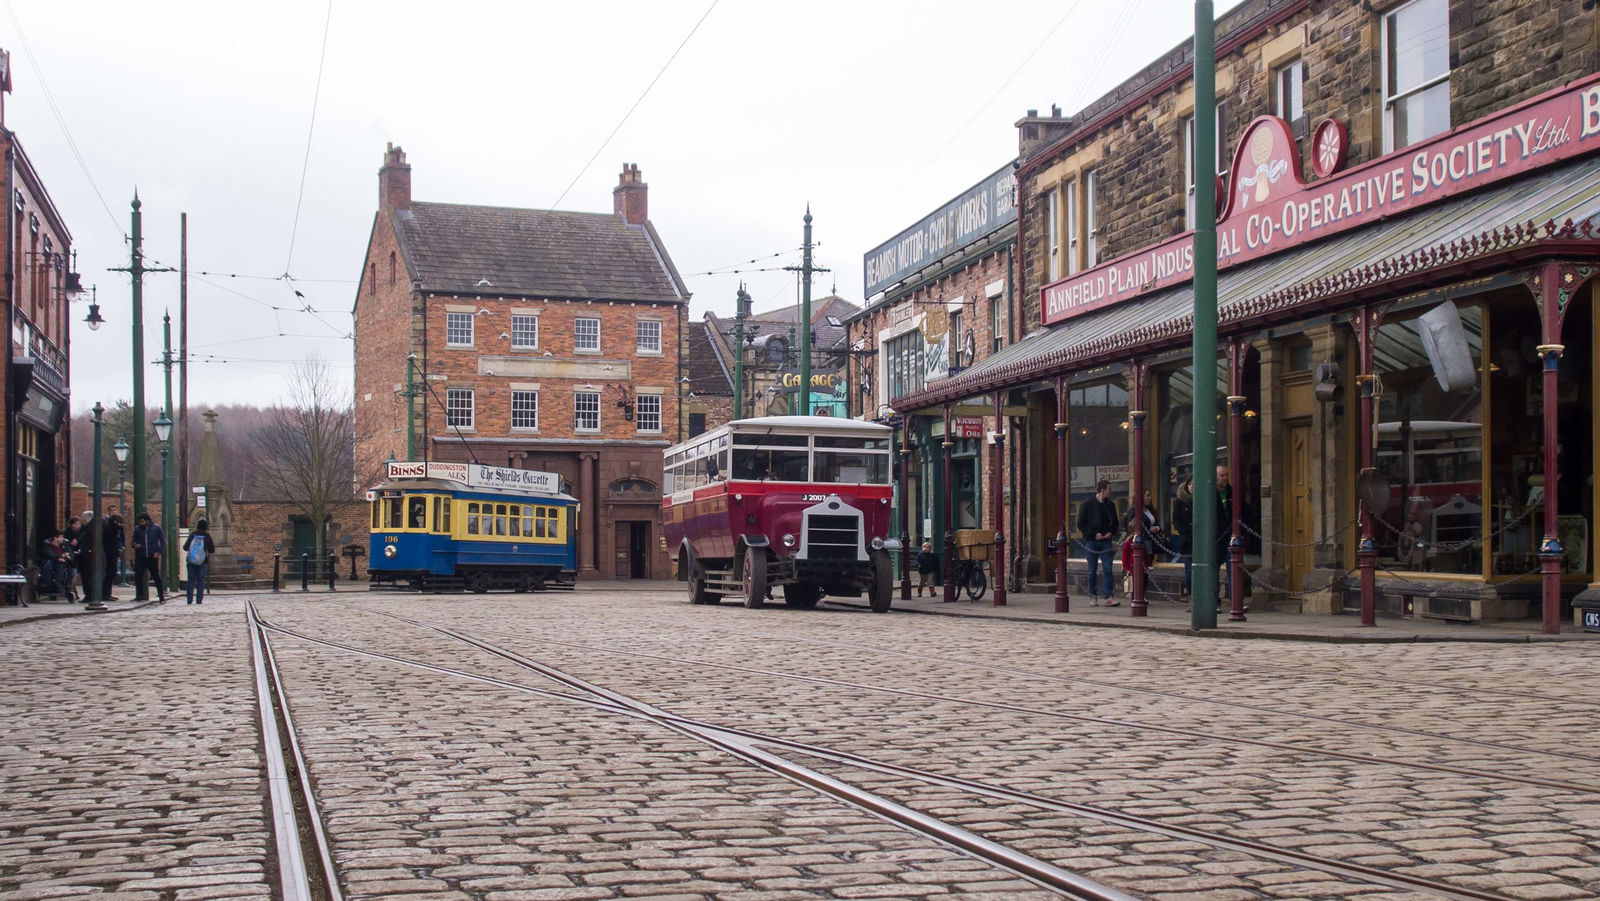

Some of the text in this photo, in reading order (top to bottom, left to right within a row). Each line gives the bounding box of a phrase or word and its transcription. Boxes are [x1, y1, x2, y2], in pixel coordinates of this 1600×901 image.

[1047, 277, 1105, 316] ANNFIELD
[1108, 258, 1147, 298] PLAIN
[1151, 232, 1240, 280] INDUSAL
[1246, 167, 1405, 250] CO-OPERATIVE
[1412, 118, 1537, 196] SOCIETY
[867, 244, 896, 288] BEAMISH
[897, 229, 924, 270] MOTOR
[929, 211, 955, 256] CYCLE
[956, 190, 988, 238] WORKS
[782, 373, 836, 388] GAAGE
[390, 464, 424, 476] BINNS
[428, 463, 467, 472] DUDDINGSTON
[447, 471, 466, 481] ALES
[480, 466, 549, 485] The Shields Gazette
[384, 535, 399, 543] 196
